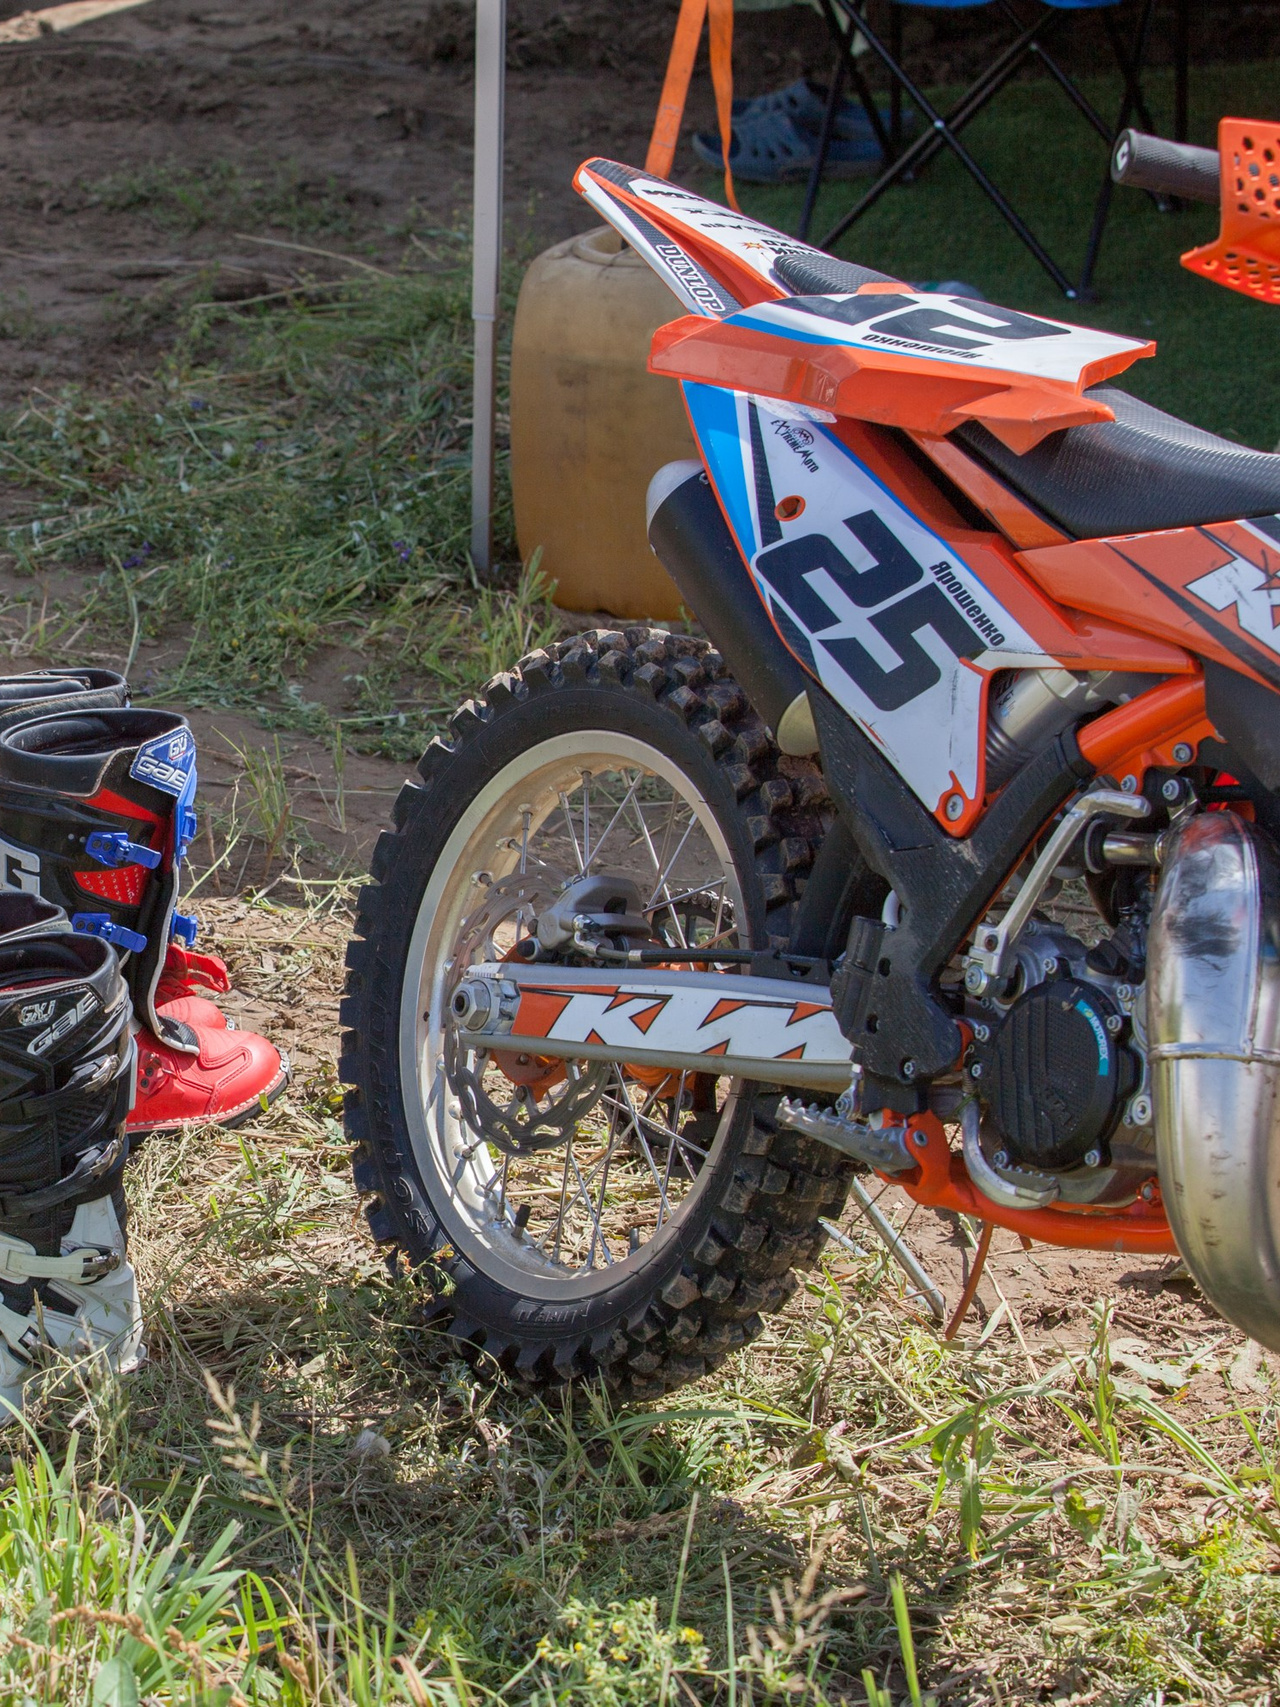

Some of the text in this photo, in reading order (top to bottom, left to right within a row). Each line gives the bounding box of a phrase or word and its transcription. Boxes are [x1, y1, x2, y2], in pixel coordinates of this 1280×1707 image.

[656, 244, 725, 311] DUNLOP
[755, 509, 989, 712] 25
[929, 561, 1006, 646] Ярошенко
[542, 984, 856, 1062] KTM
[1090, 1016, 1109, 1061] MOTOREX
